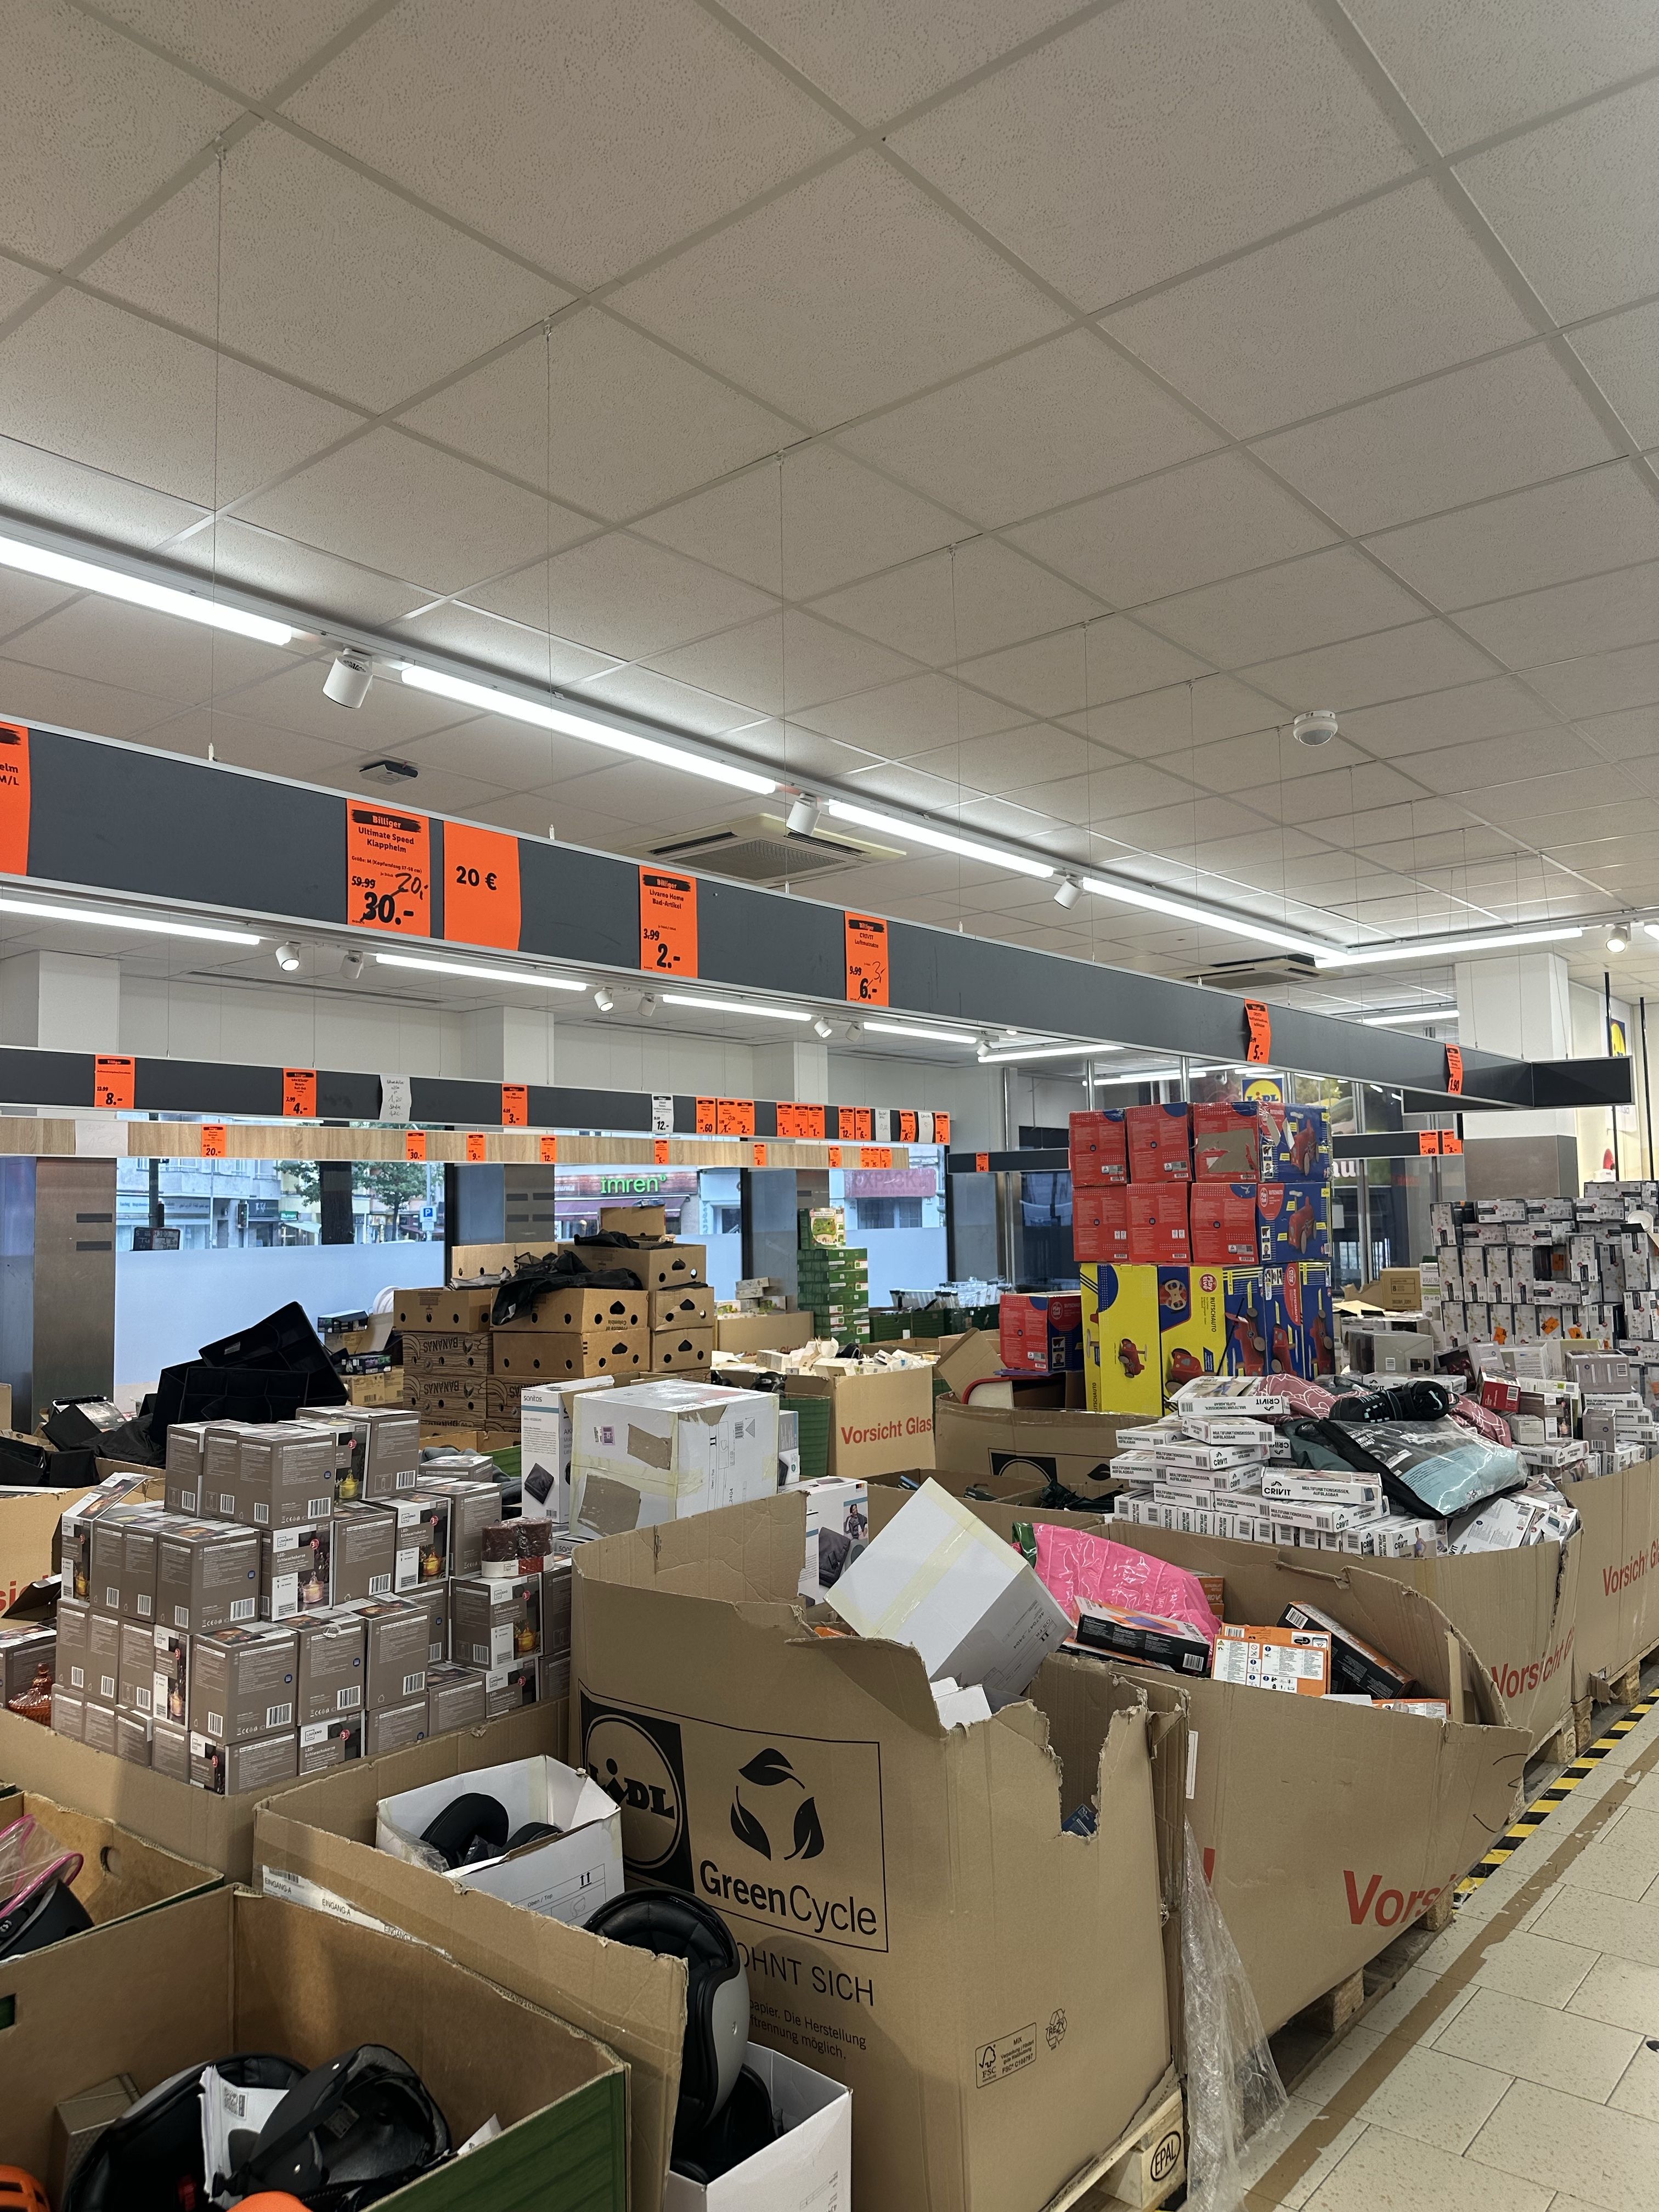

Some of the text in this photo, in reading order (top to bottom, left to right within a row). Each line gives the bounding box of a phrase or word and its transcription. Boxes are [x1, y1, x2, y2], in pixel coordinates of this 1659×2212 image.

[373, 815, 401, 829] Billiger
[358, 827, 414, 845] Ultimate Speed
[367, 838, 406, 853] Klapphelm
[456, 865, 497, 891] 20 €
[657, 879, 677, 889] Billiger
[650, 889, 684, 901] Livarno Home
[652, 898, 681, 909] Bad-Artikel
[105, 1092, 123, 1105] 8.-
[293, 1103, 308, 1114] 4.-
[657, 1121, 669, 1131] 12.-
[601, 1176, 658, 1194] imren
[424, 1337, 458, 1352] BANANAS
[424, 1381, 459, 1395] BANANAS
[841, 1421, 902, 1444] Vorsicht
[1214, 1457, 1228, 1466] CRIVIT
[1263, 1487, 1291, 1496] CRIVIT
[1336, 1520, 1349, 1529] CRIVIT
[1394, 1540, 1408, 1549] CRIVIT
[1492, 1641, 1563, 1698] Vorsicht
[264, 1877, 293, 1895] EINGANG-A
[527, 1899, 540, 1908] Oben
[699, 1859, 877, 1936] GreenCycle
[1343, 1870, 1457, 1927] Vors
[322, 1898, 351, 1917] EINGANG-A
[738, 1942, 874, 2007] OHNT SICH
[748, 1999, 867, 2050] papier. Die Herstellung
[802, 2034, 847, 2060] möglich.
[1013, 2037, 1022, 2046] MIX
[982, 2066, 997, 2079] FSC
[1154, 2140, 1177, 2175] EPAL
